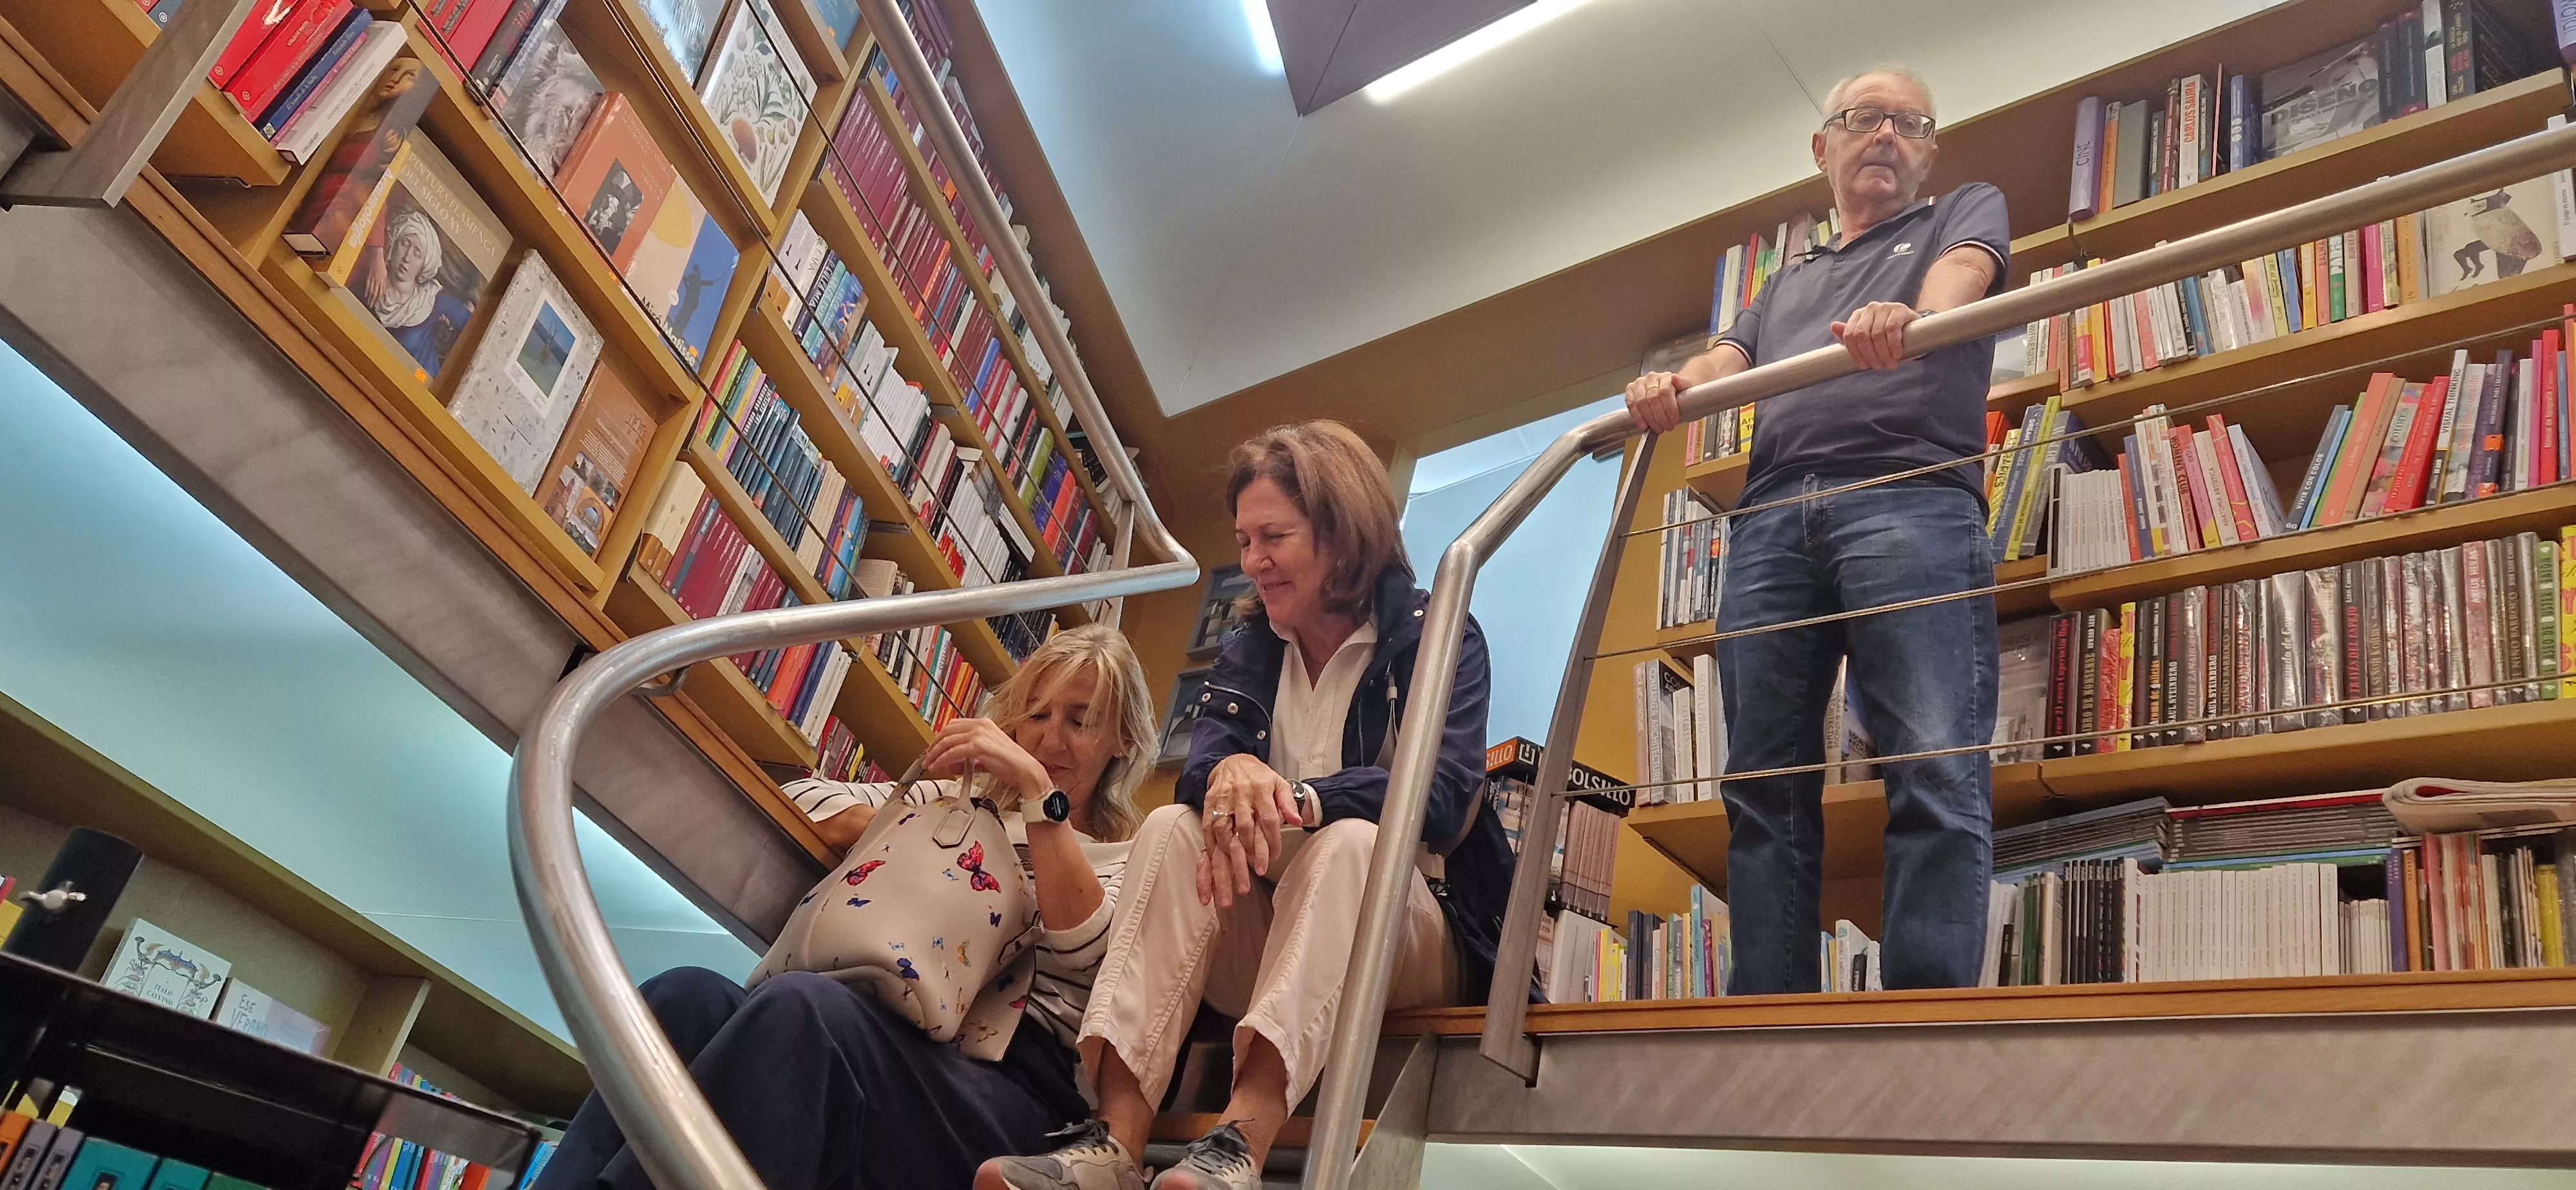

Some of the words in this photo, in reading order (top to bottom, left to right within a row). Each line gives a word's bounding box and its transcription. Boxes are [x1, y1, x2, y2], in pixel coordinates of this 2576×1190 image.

[2185, 81, 2196, 109] SAURA
[2271, 78, 2378, 126] DISEÑO
[2184, 110, 2195, 144] CARLOS
[2076, 140, 2090, 166] CINE
[401, 165, 419, 187] DEL
[420, 185, 449, 221] SIGLO
[450, 216, 463, 235] XV
[408, 151, 450, 204] PINTURA
[449, 201, 497, 258] FLAMENCA
[661, 321, 696, 368] Matisse
[2441, 402, 2453, 434] VISUAL
[2447, 368, 2461, 405] THINKING
[2177, 475, 2189, 495] CLUB
[2295, 487, 2309, 510] VIVIR
[2305, 472, 2315, 491] CON
[2311, 453, 2325, 475] COLOR
[2509, 591, 2522, 639] BARROCO
[2221, 634, 2231, 677] BARROCO
[1648, 666, 1659, 717] CONTAINER
[1697, 673, 1706, 702] SLOW
[2169, 661, 2178, 707] STEINBERG
[2208, 654, 2217, 703] STEINBERG
[1698, 703, 1707, 733] LIVING
[1826, 694, 1835, 750] ARCHITECTURE
[2082, 697, 2094, 709] DE
[2168, 708, 2177, 724] SAUL
[2208, 703, 2217, 719] SAUL
[1651, 719, 1661, 784] ARCHITECTURE
[146, 990, 174, 1006] CALVINO
[153, 983, 173, 996] ITALO
